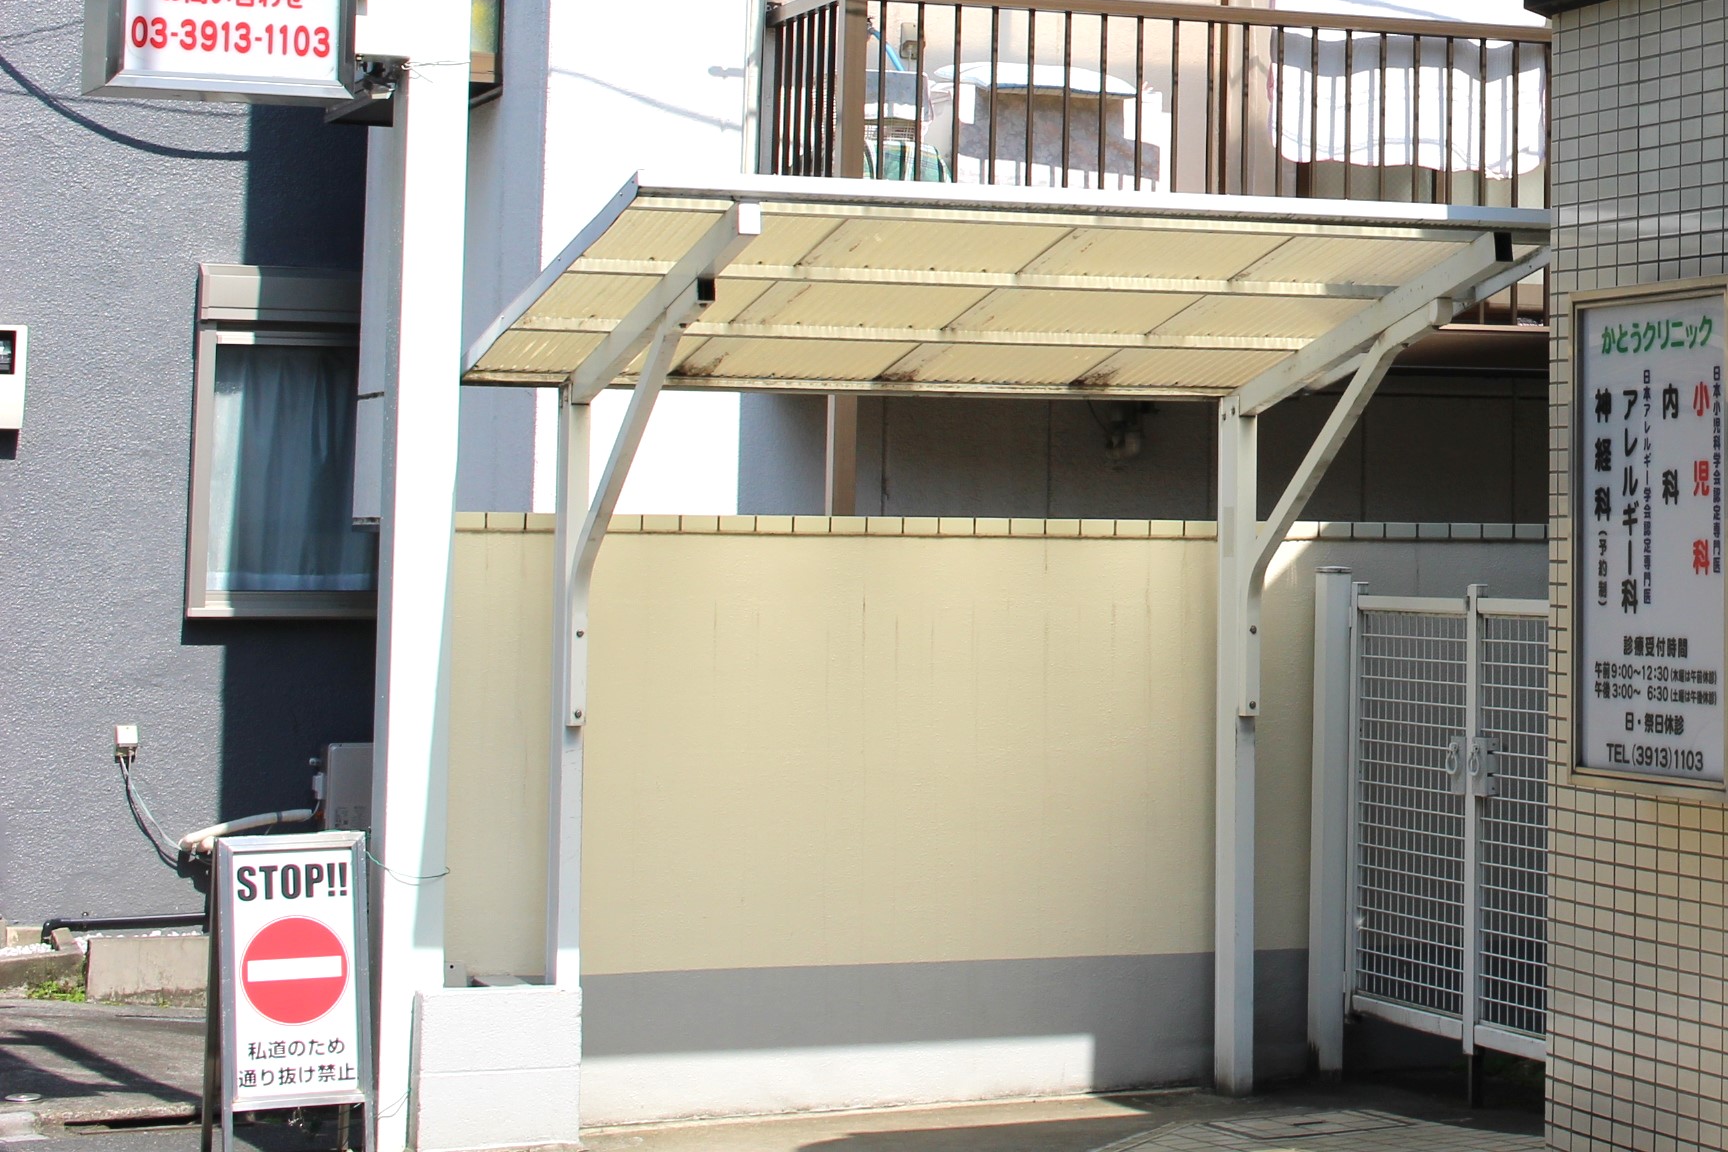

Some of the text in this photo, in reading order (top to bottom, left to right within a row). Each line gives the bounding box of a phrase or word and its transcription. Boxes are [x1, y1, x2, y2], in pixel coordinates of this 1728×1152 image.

[131, 15, 331, 59] 03-3913-1103
[1602, 315, 1712, 354] かとうクリニック
[1621, 389, 1639, 614] アレルギー科
[1623, 636, 1688, 658] 診療受付時間
[237, 862, 348, 901] STOP!!
[248, 1038, 345, 1060] 私道のため
[238, 1062, 357, 1089] 通り抜け禁止
